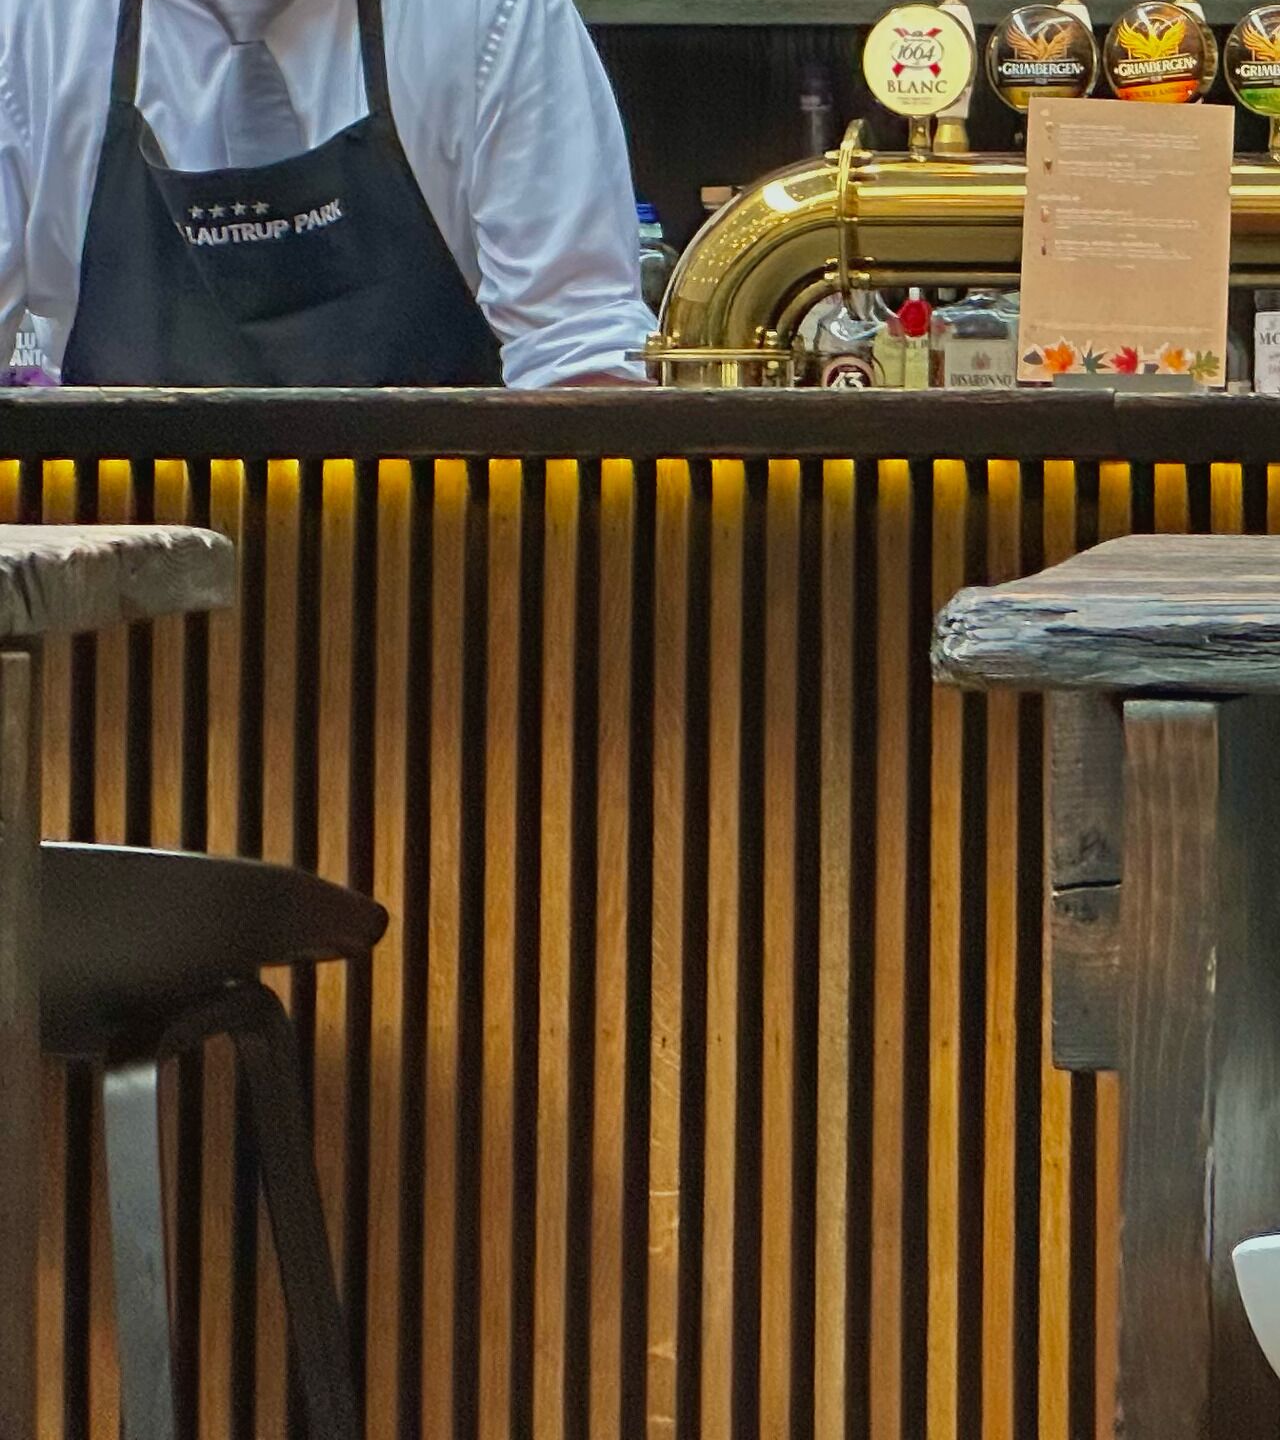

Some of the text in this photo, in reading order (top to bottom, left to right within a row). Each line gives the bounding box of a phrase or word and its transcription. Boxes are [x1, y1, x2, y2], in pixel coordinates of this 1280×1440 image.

[897, 43, 936, 62] 1664
[1002, 62, 1081, 76] GRIMBERGEN
[1118, 57, 1194, 77] GRIMBERGEN
[886, 79, 948, 94] BLANC
[185, 198, 344, 247] LAUTRUP PARK
